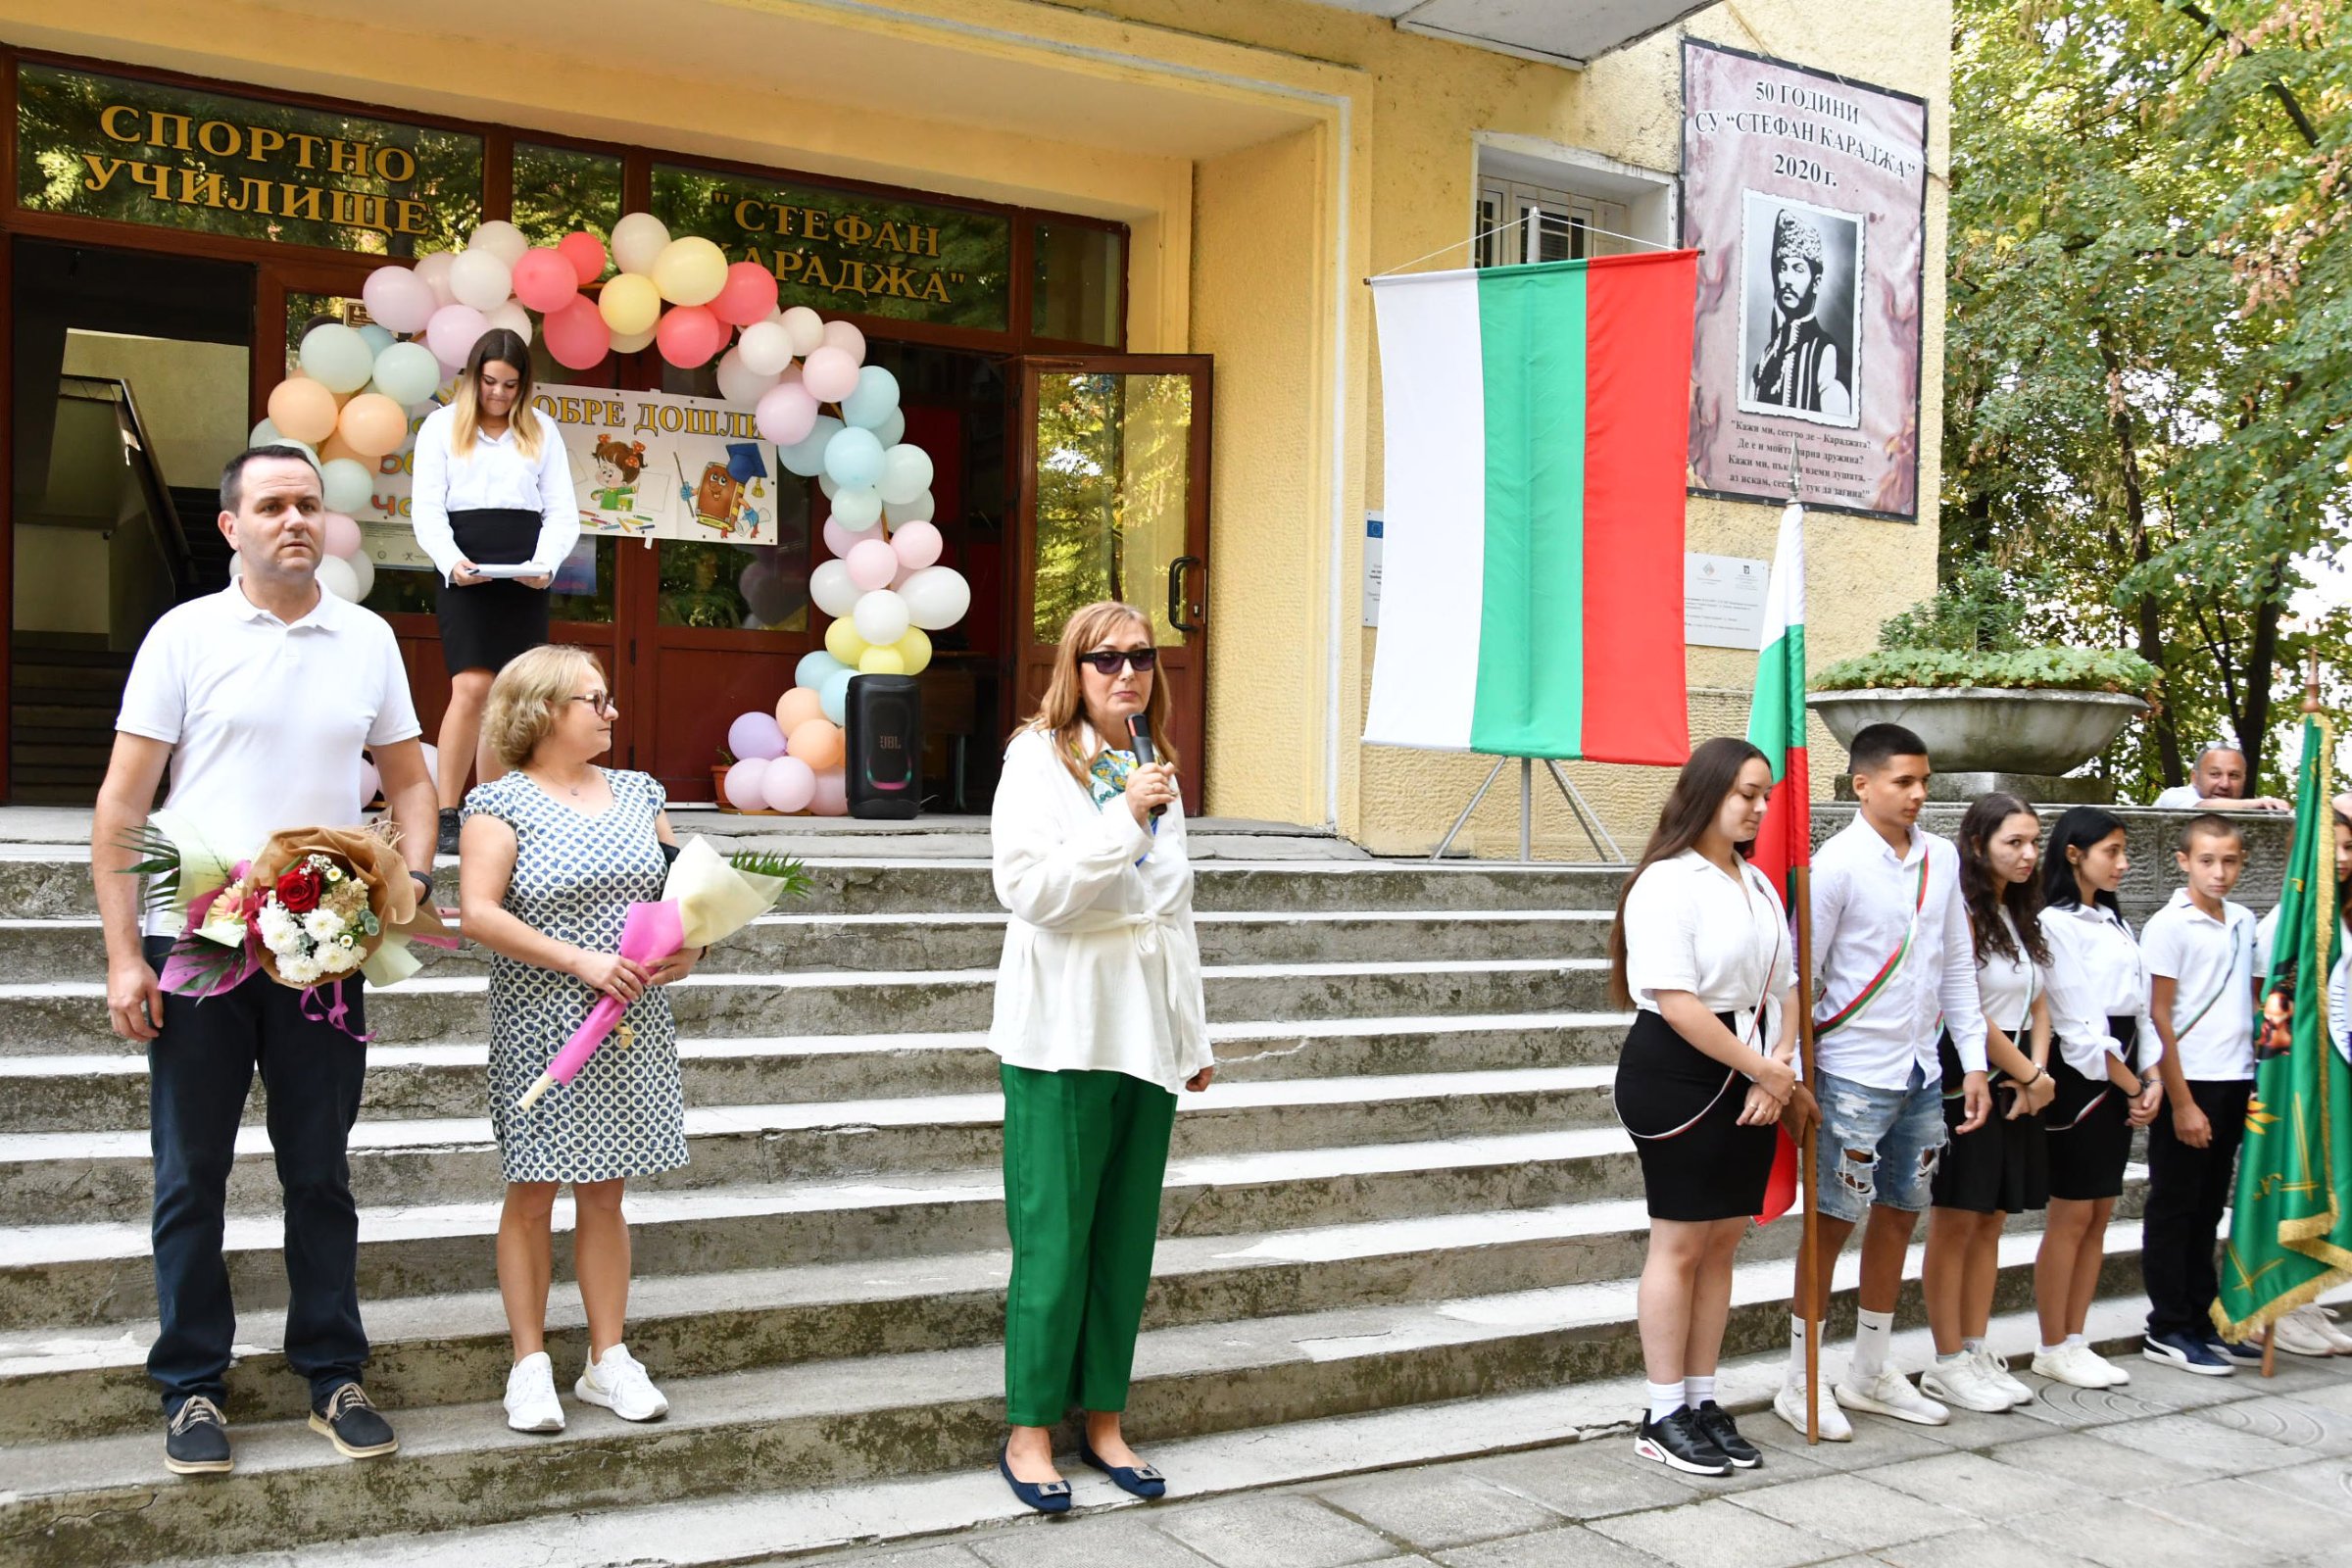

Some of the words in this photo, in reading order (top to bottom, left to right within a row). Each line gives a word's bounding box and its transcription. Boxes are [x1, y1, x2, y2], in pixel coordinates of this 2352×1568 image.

[1755, 81, 1775, 102] 50
[1781, 84, 1860, 124] ГОДИНИ
[100, 105, 416, 182] СПОРТНО
[1695, 112, 1720, 132] СУ
[1726, 113, 1814, 142] “СТЕФАН
[1821, 128, 1916, 177] КАРАДЖА”
[81, 154, 430, 237] УЧИЛИЩЕ
[712, 191, 940, 258] "СТЕФАН
[532, 394, 626, 428] ОБРЕ
[1738, 438, 1749, 449] Де
[1762, 425, 1776, 437] ми,
[1728, 454, 1753, 466] Кажи
[1805, 466, 1831, 477] вземи
[1806, 484, 1821, 494] тук
[880, 736, 902, 750] JBL
